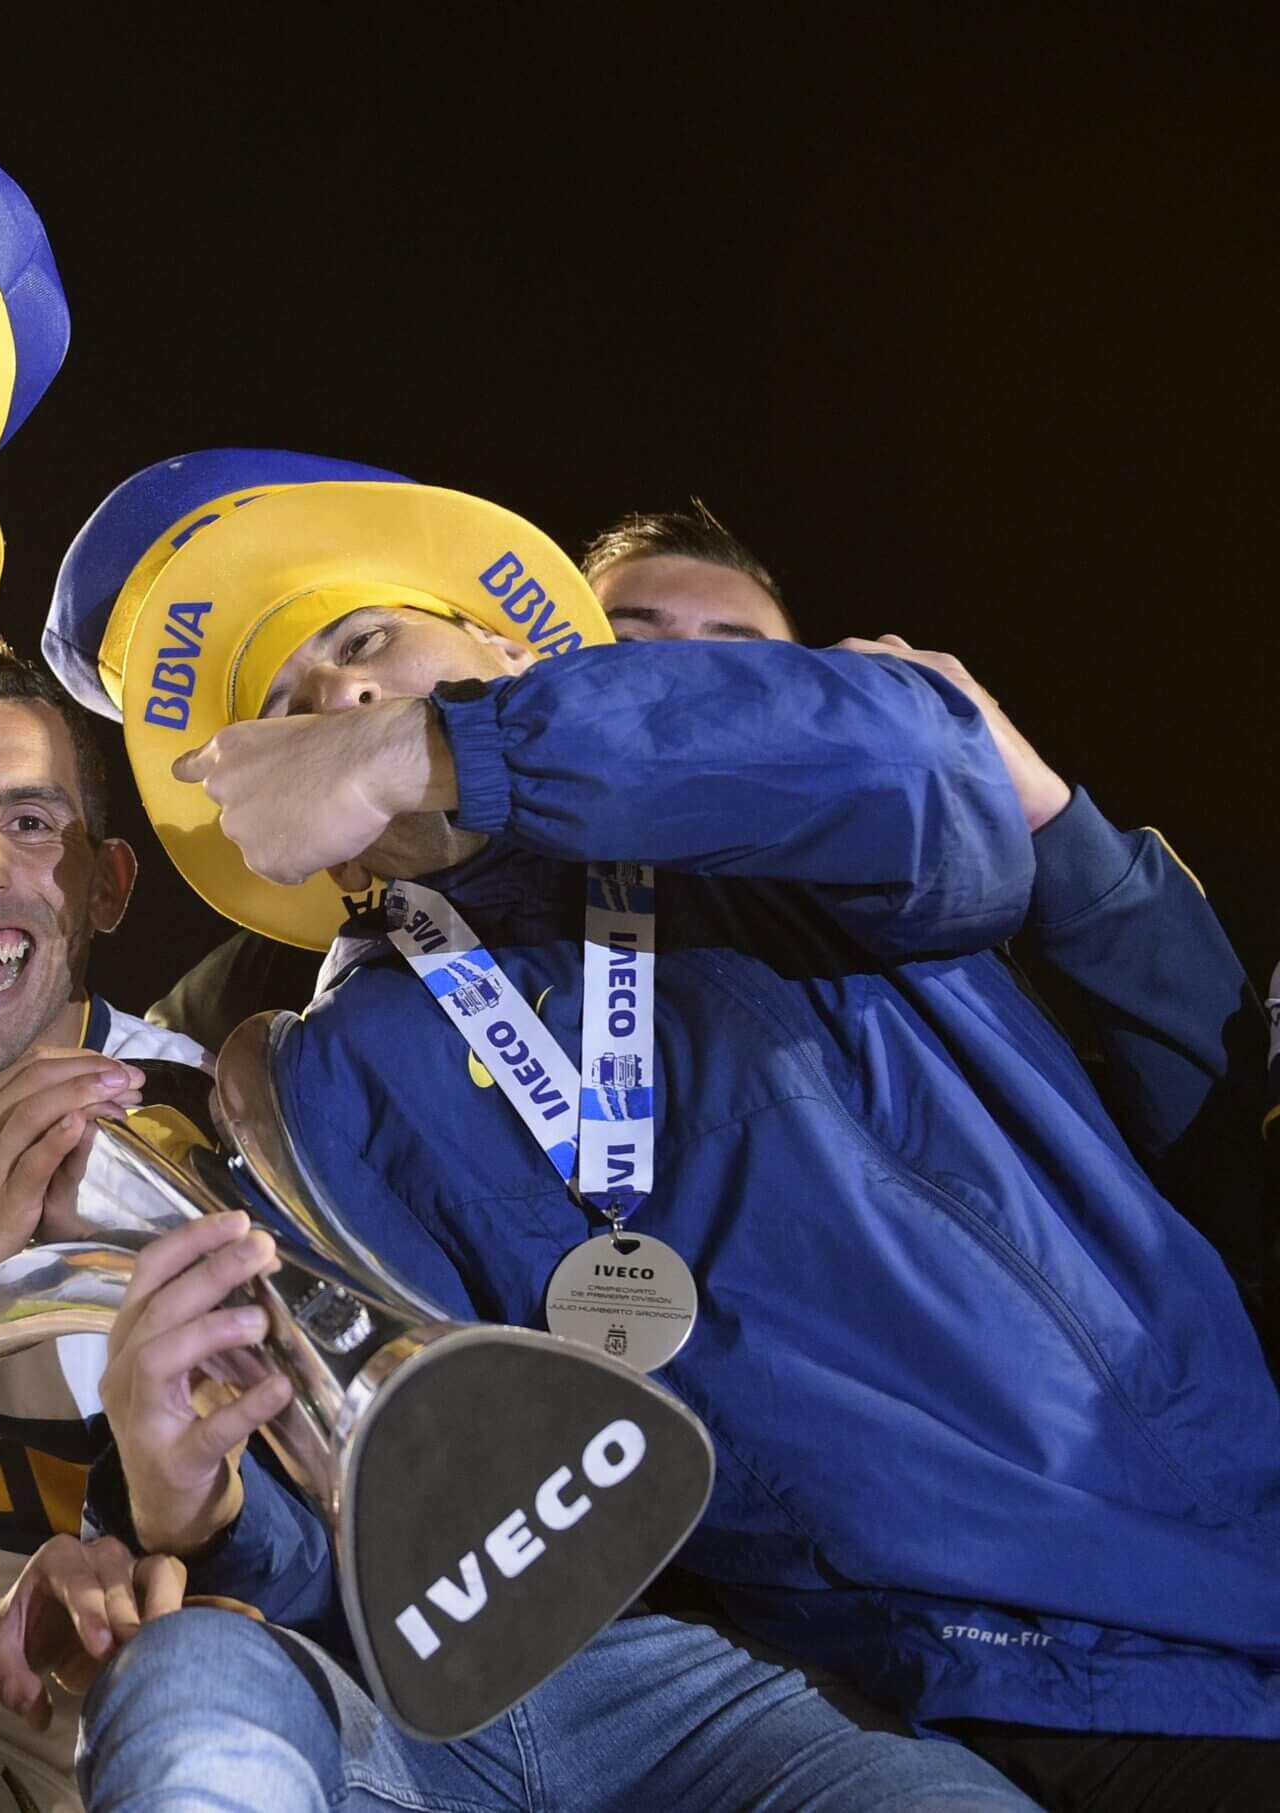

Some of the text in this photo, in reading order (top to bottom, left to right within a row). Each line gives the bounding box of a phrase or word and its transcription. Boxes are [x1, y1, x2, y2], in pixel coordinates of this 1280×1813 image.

[478, 550, 583, 657] BBVA
[143, 599, 213, 731] BBVA
[608, 931, 637, 1038] IVECO
[486, 1020, 571, 1121] IVECO
[594, 1264, 655, 1280] IVECO
[394, 1418, 647, 1660] IVECO
[941, 1625, 1053, 1647] STORM-FIT
